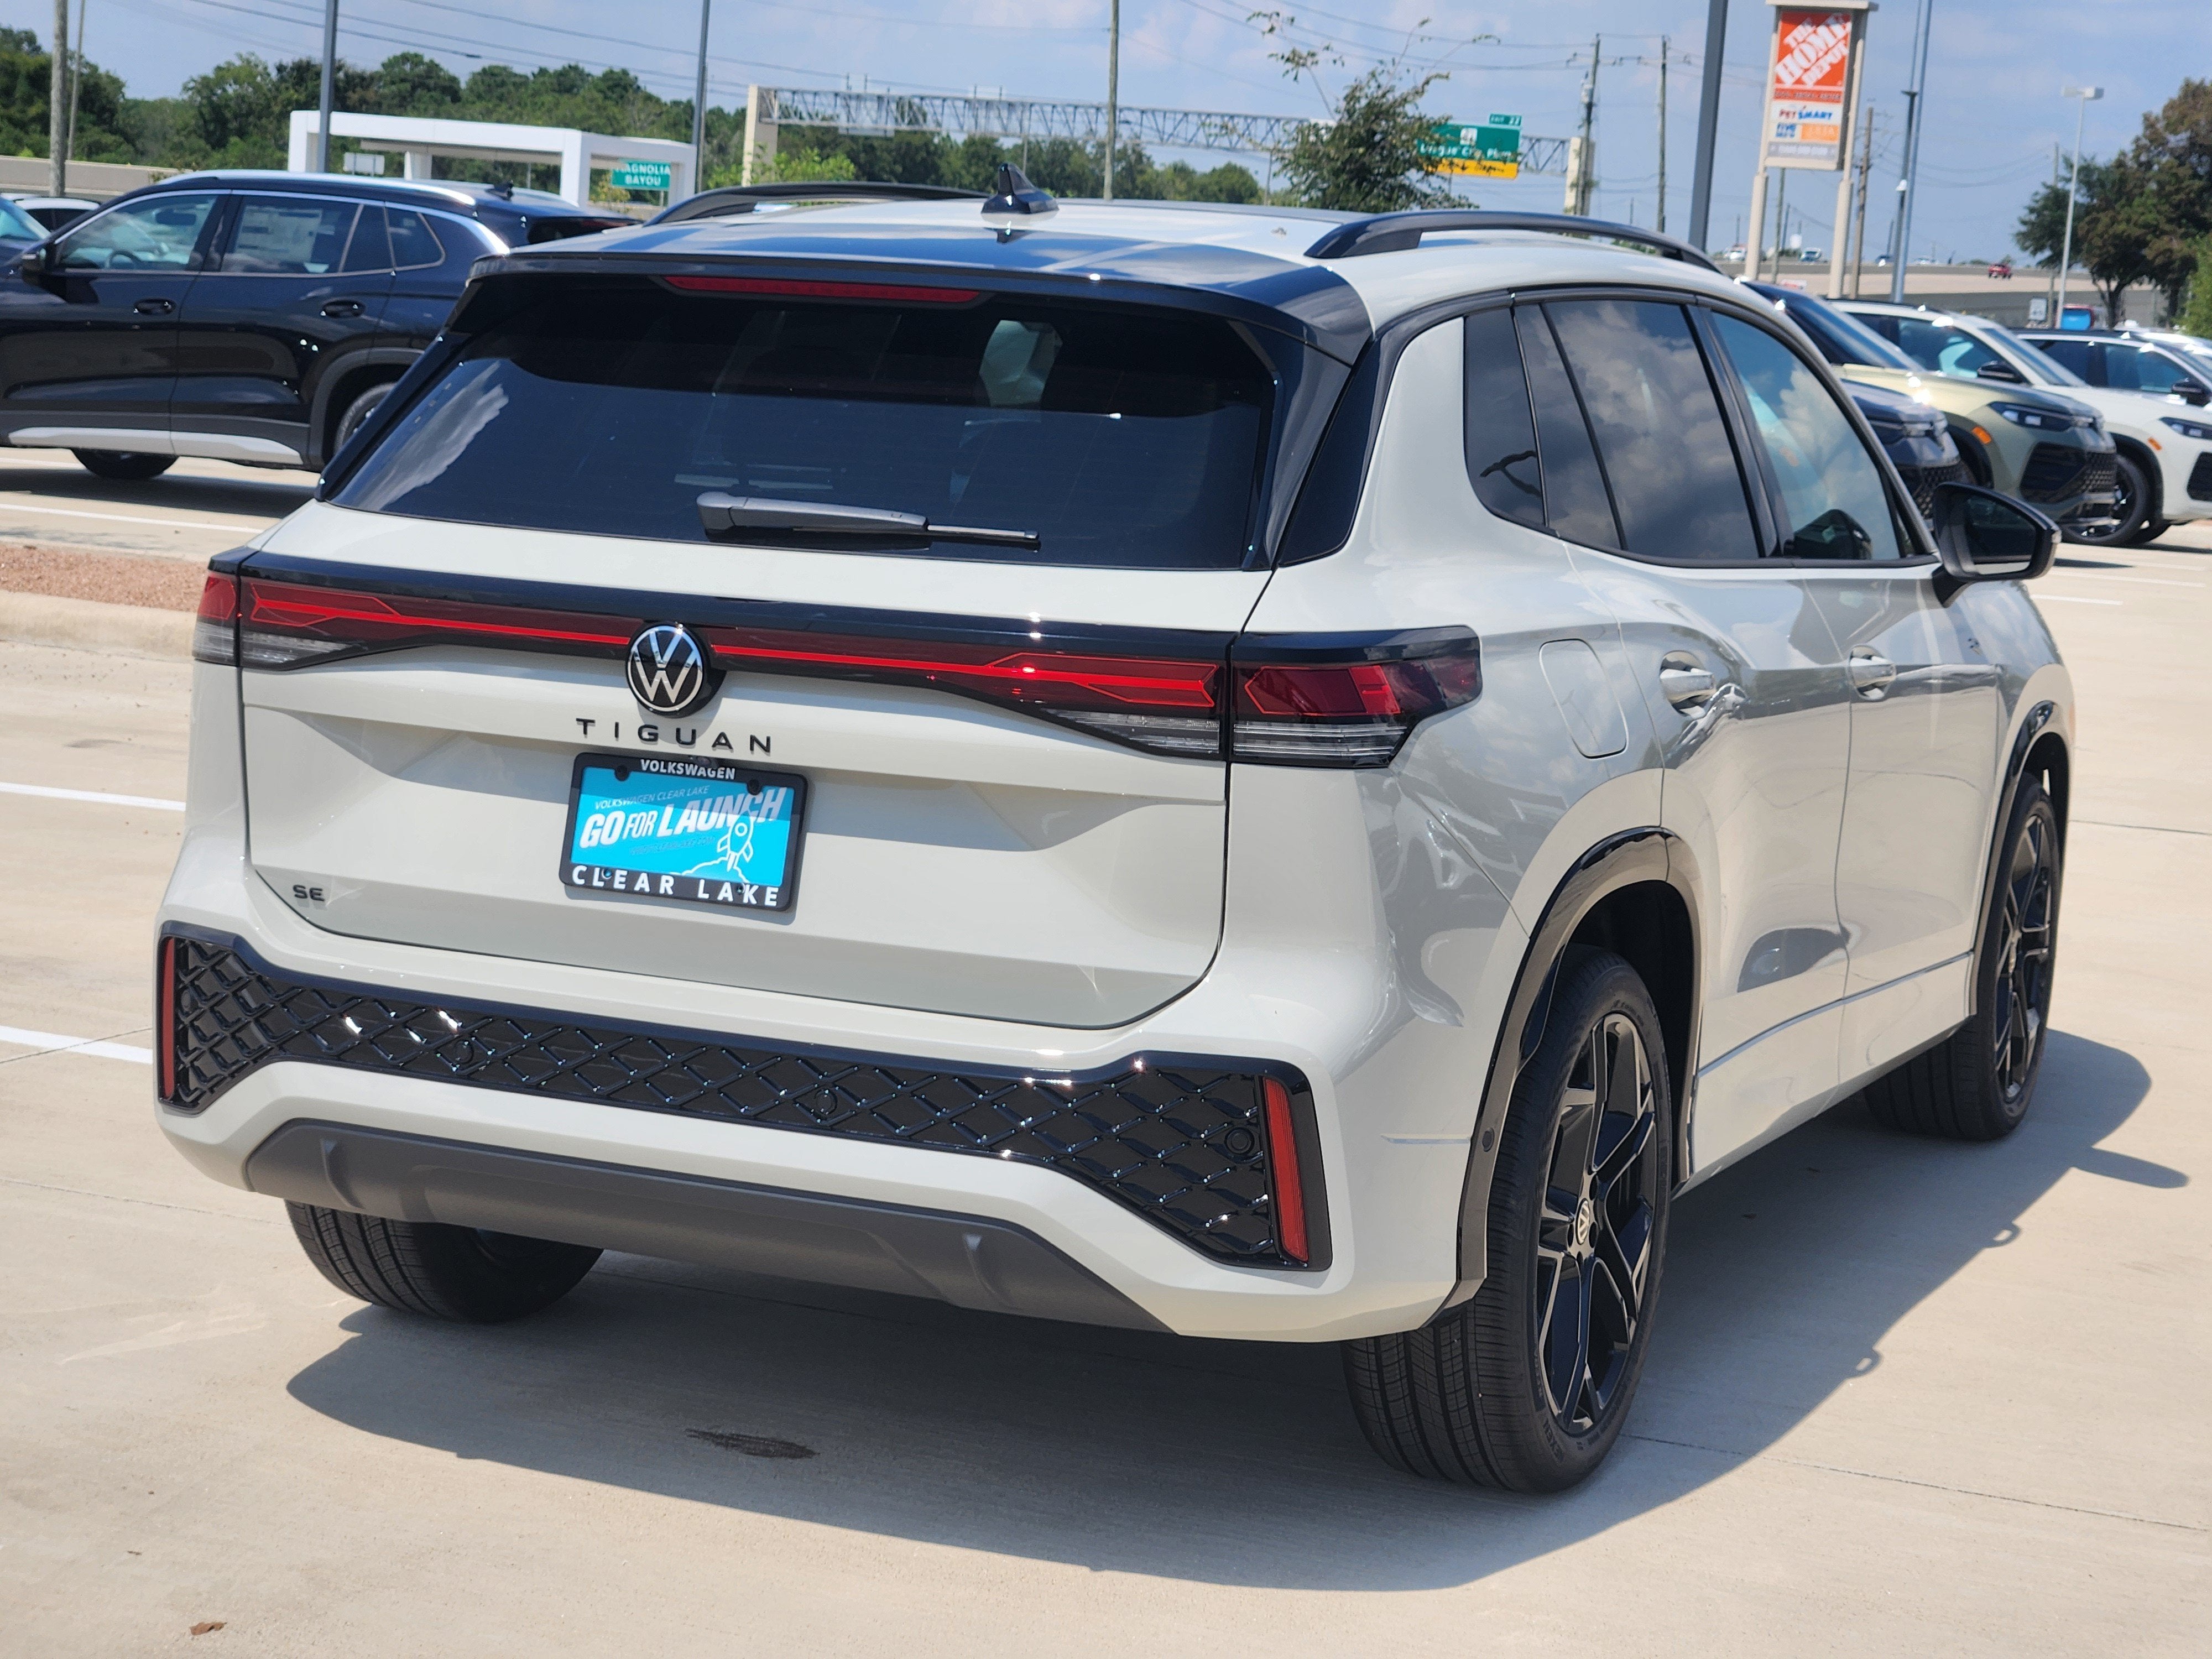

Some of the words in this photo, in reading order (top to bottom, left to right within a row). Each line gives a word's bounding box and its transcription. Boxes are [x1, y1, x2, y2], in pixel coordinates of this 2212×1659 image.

[1775, 14, 1851, 85] HOME
[1801, 40, 1849, 87] DEPOT
[624, 174, 661, 186] BAYOU
[576, 717, 771, 753] TIGUAN
[640, 759, 736, 780] VOLKSWAGEN
[594, 793, 655, 810] VOLKSWAGEN
[655, 789, 686, 804] CLEAR
[686, 785, 711, 799] LAKE
[579, 810, 625, 849] GO
[622, 810, 658, 841] FOR
[656, 786, 788, 838] LAUNCH
[293, 884, 325, 902] SE
[572, 864, 675, 895] CLEAR
[697, 881, 780, 907] LAKE
